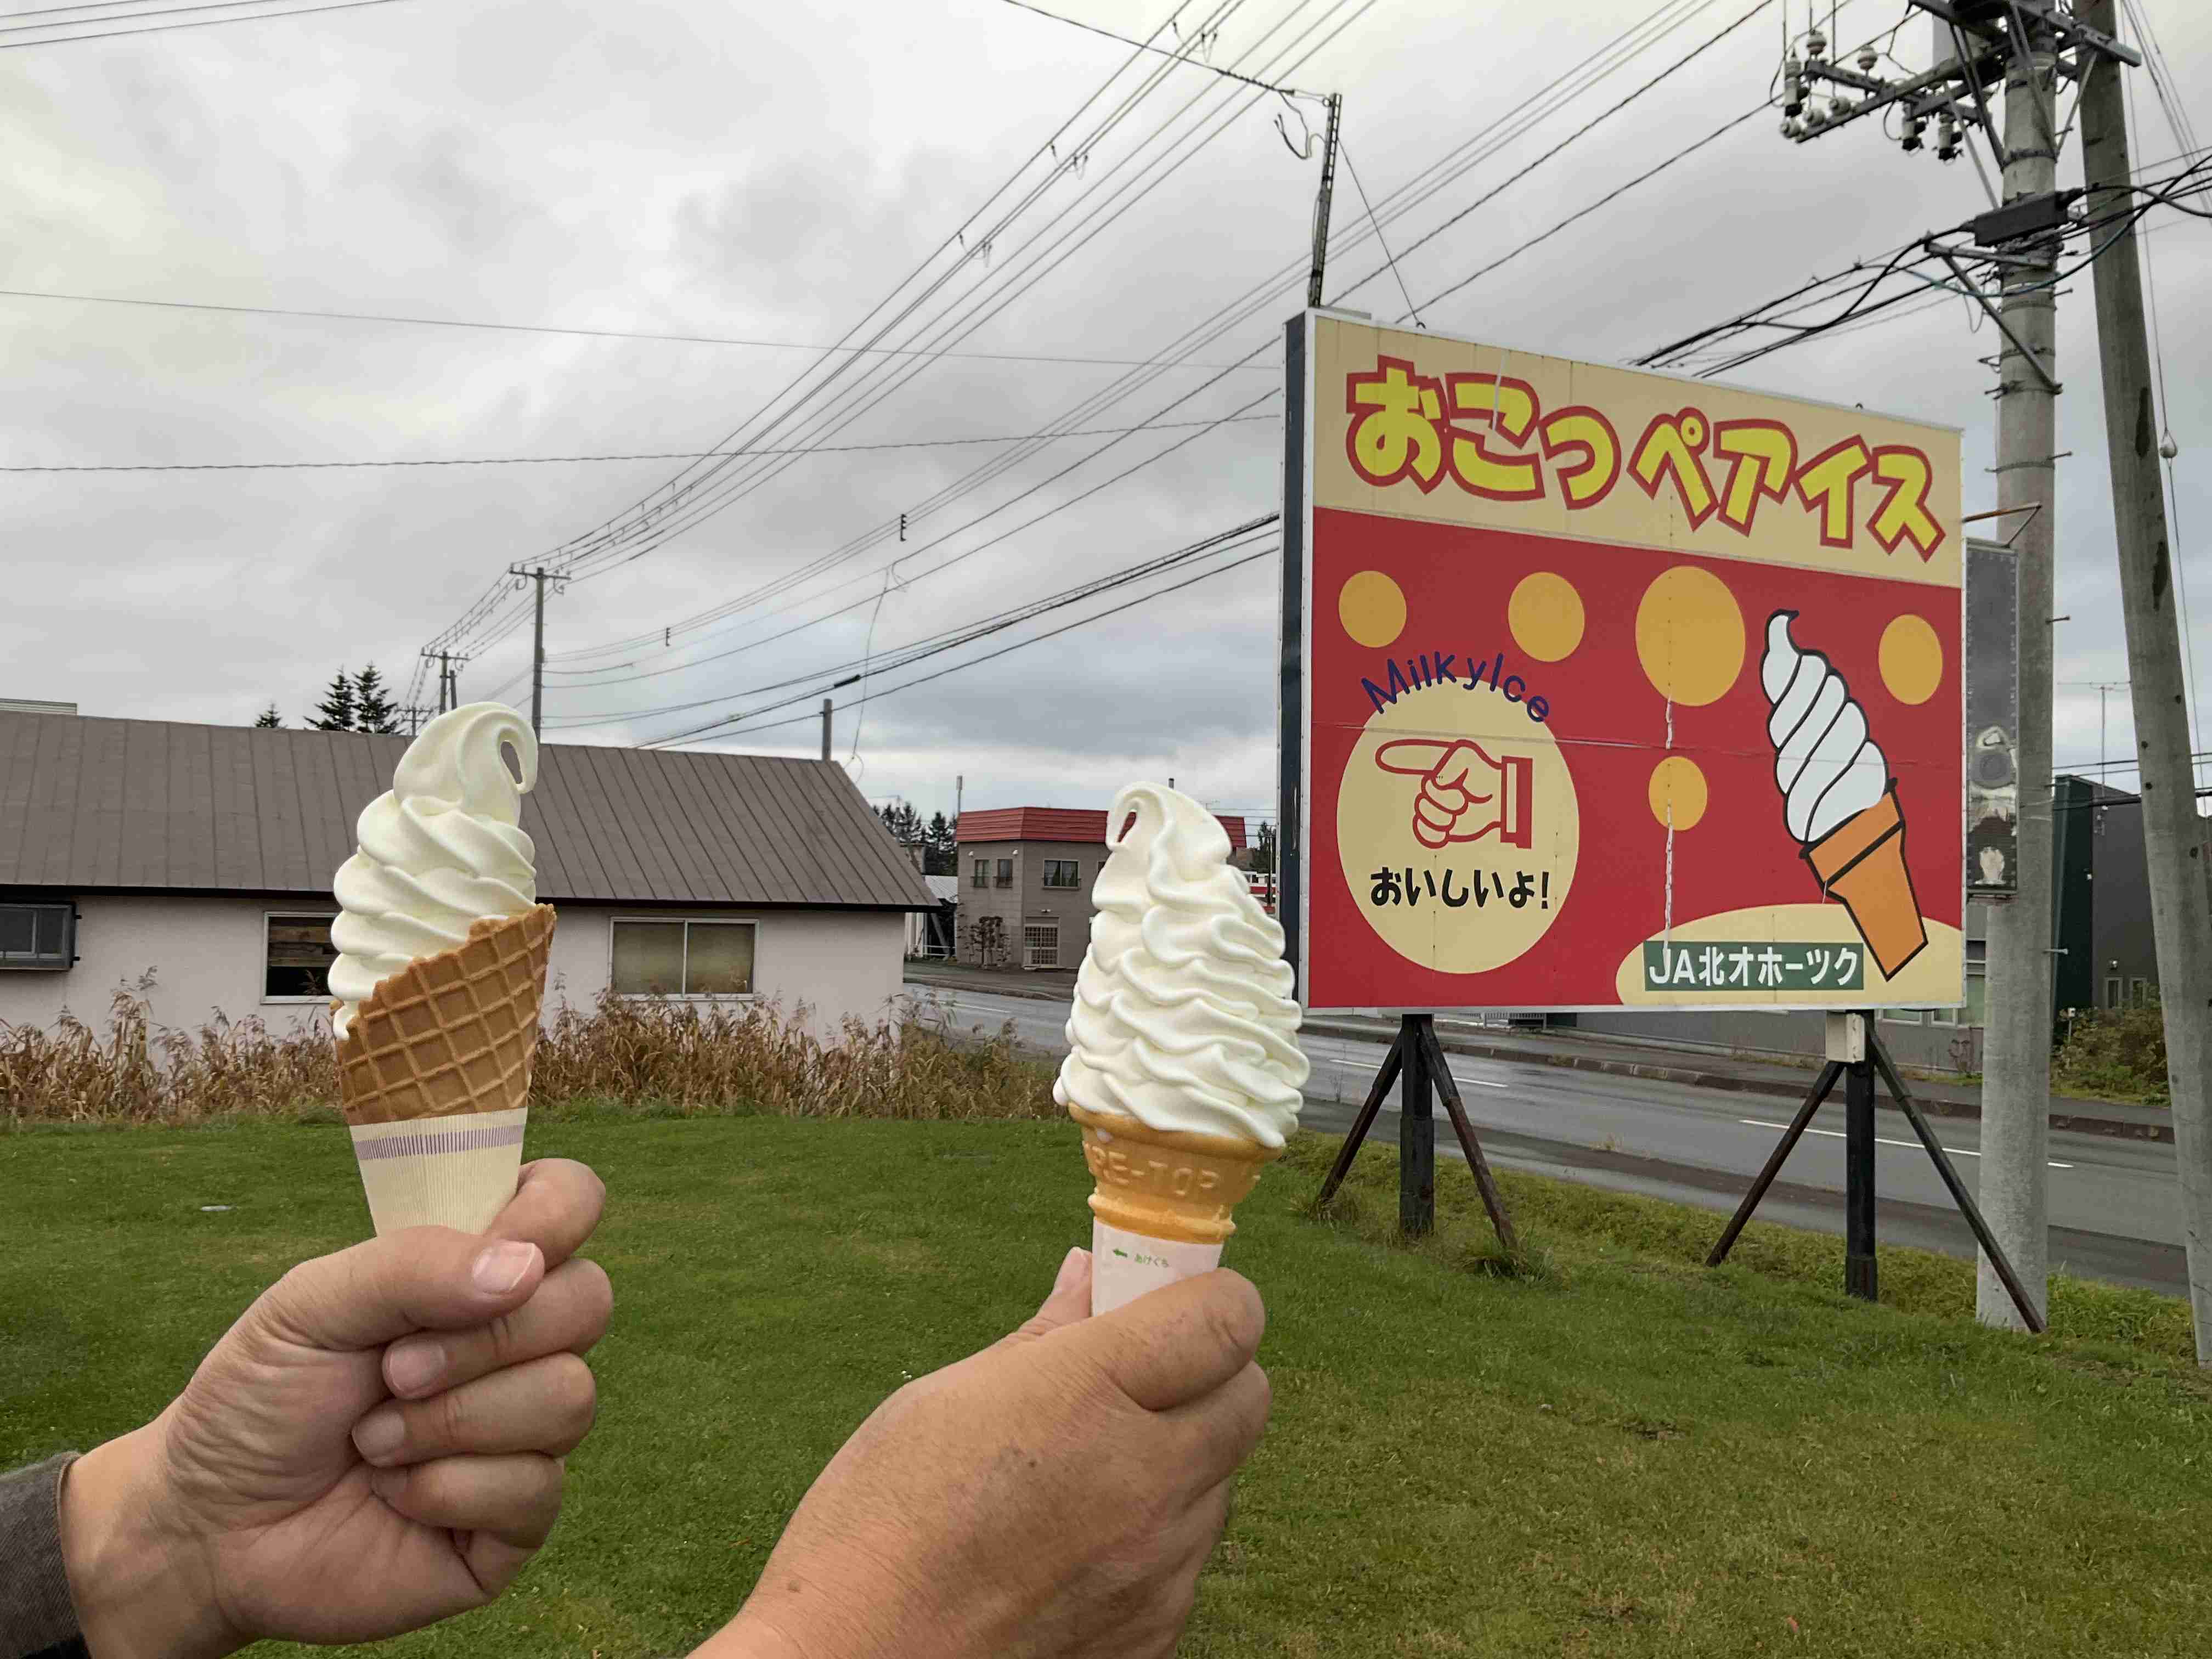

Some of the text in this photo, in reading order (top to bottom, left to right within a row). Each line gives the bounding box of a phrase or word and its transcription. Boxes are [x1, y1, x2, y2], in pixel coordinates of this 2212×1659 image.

[1649, 946, 1858, 986] JA北オホーツク
